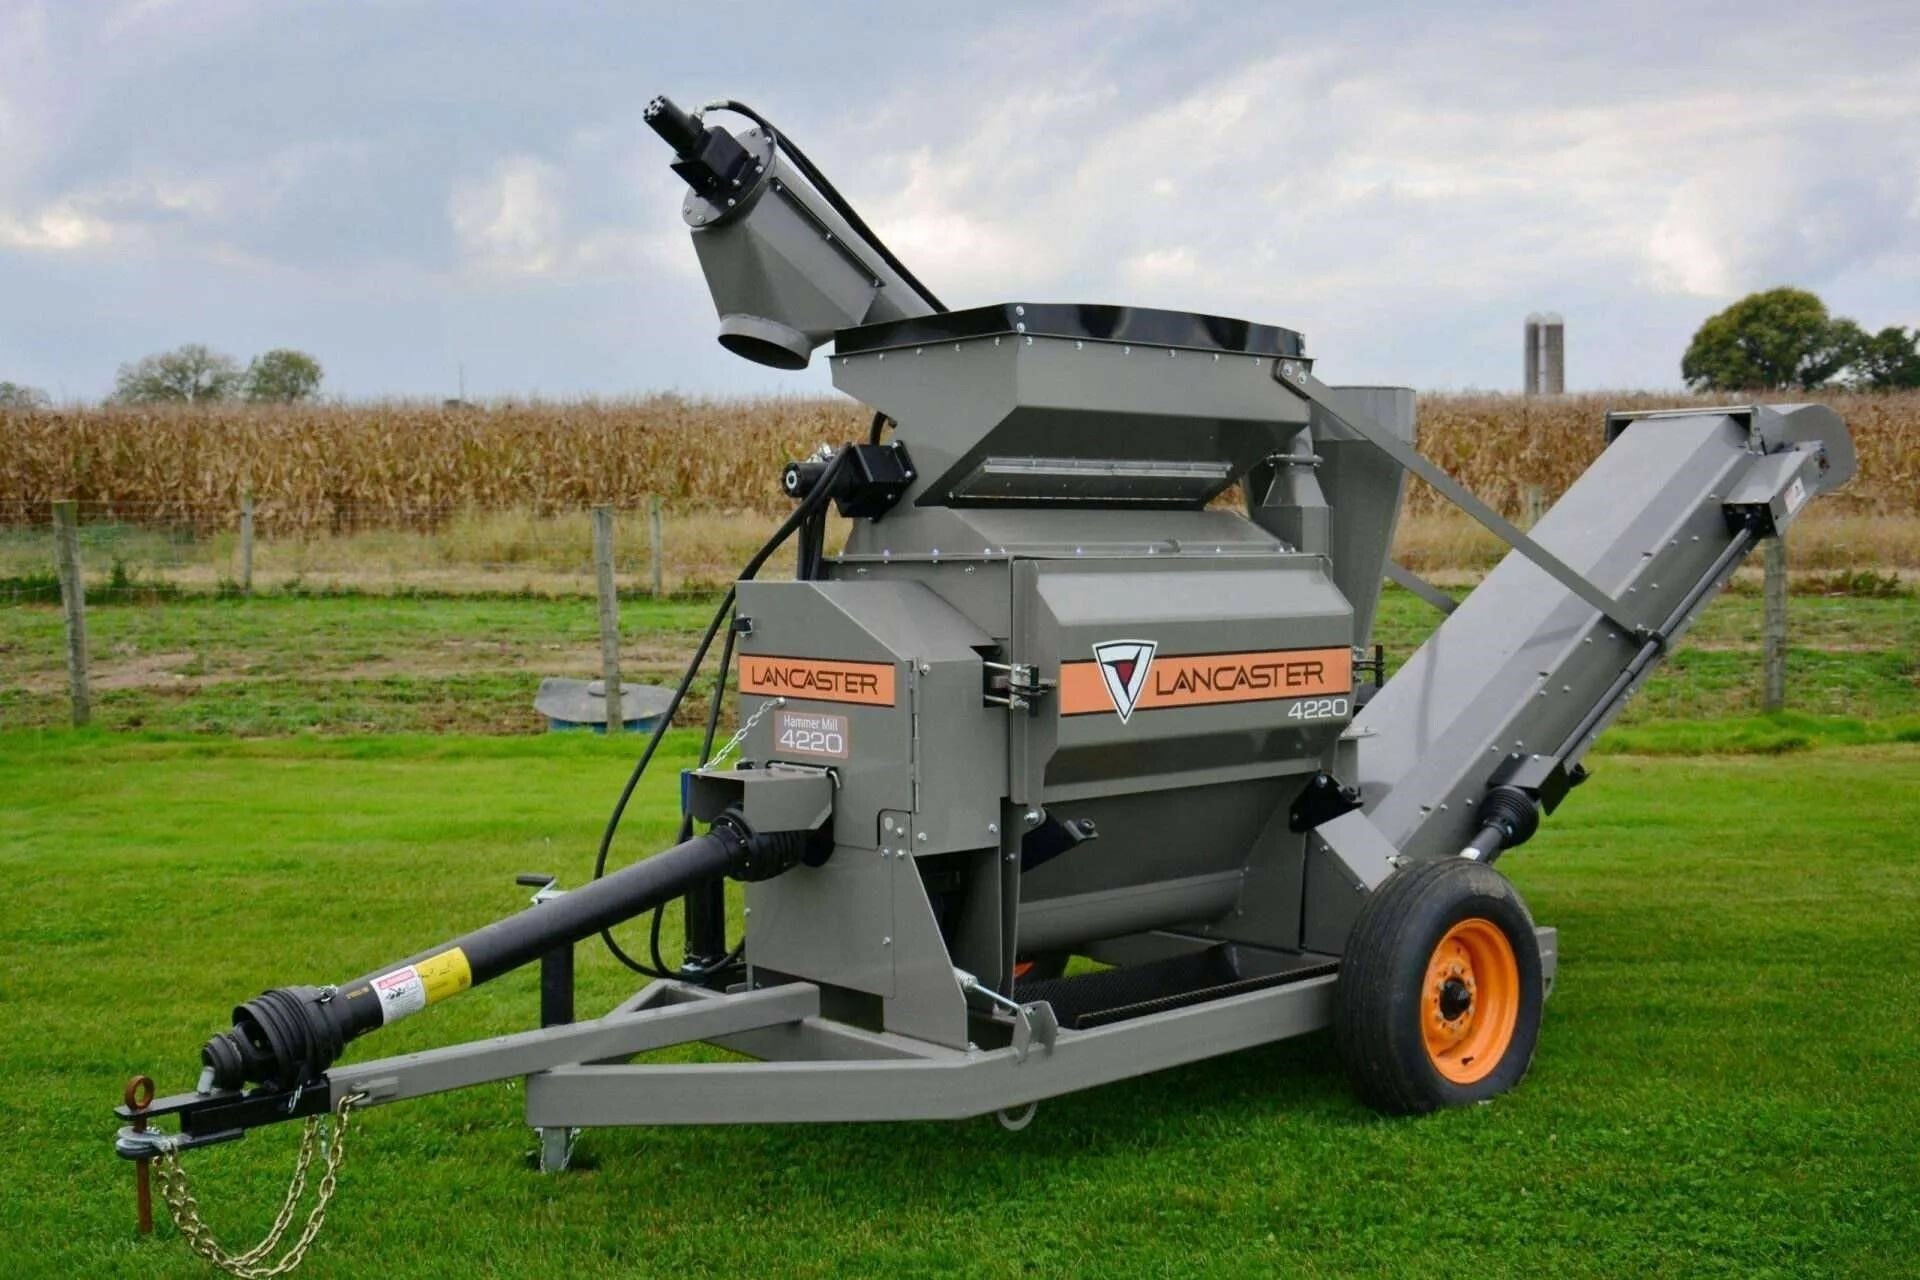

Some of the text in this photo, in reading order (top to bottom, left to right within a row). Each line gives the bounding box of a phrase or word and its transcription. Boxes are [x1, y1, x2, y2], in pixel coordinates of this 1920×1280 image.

[752, 665, 878, 695] LANCASTER
[1156, 661, 1324, 696] LANCASTER
[1287, 698, 1348, 720] 4220
[783, 715, 839, 731] Hammer Mill
[780, 729, 843, 754] 4220
